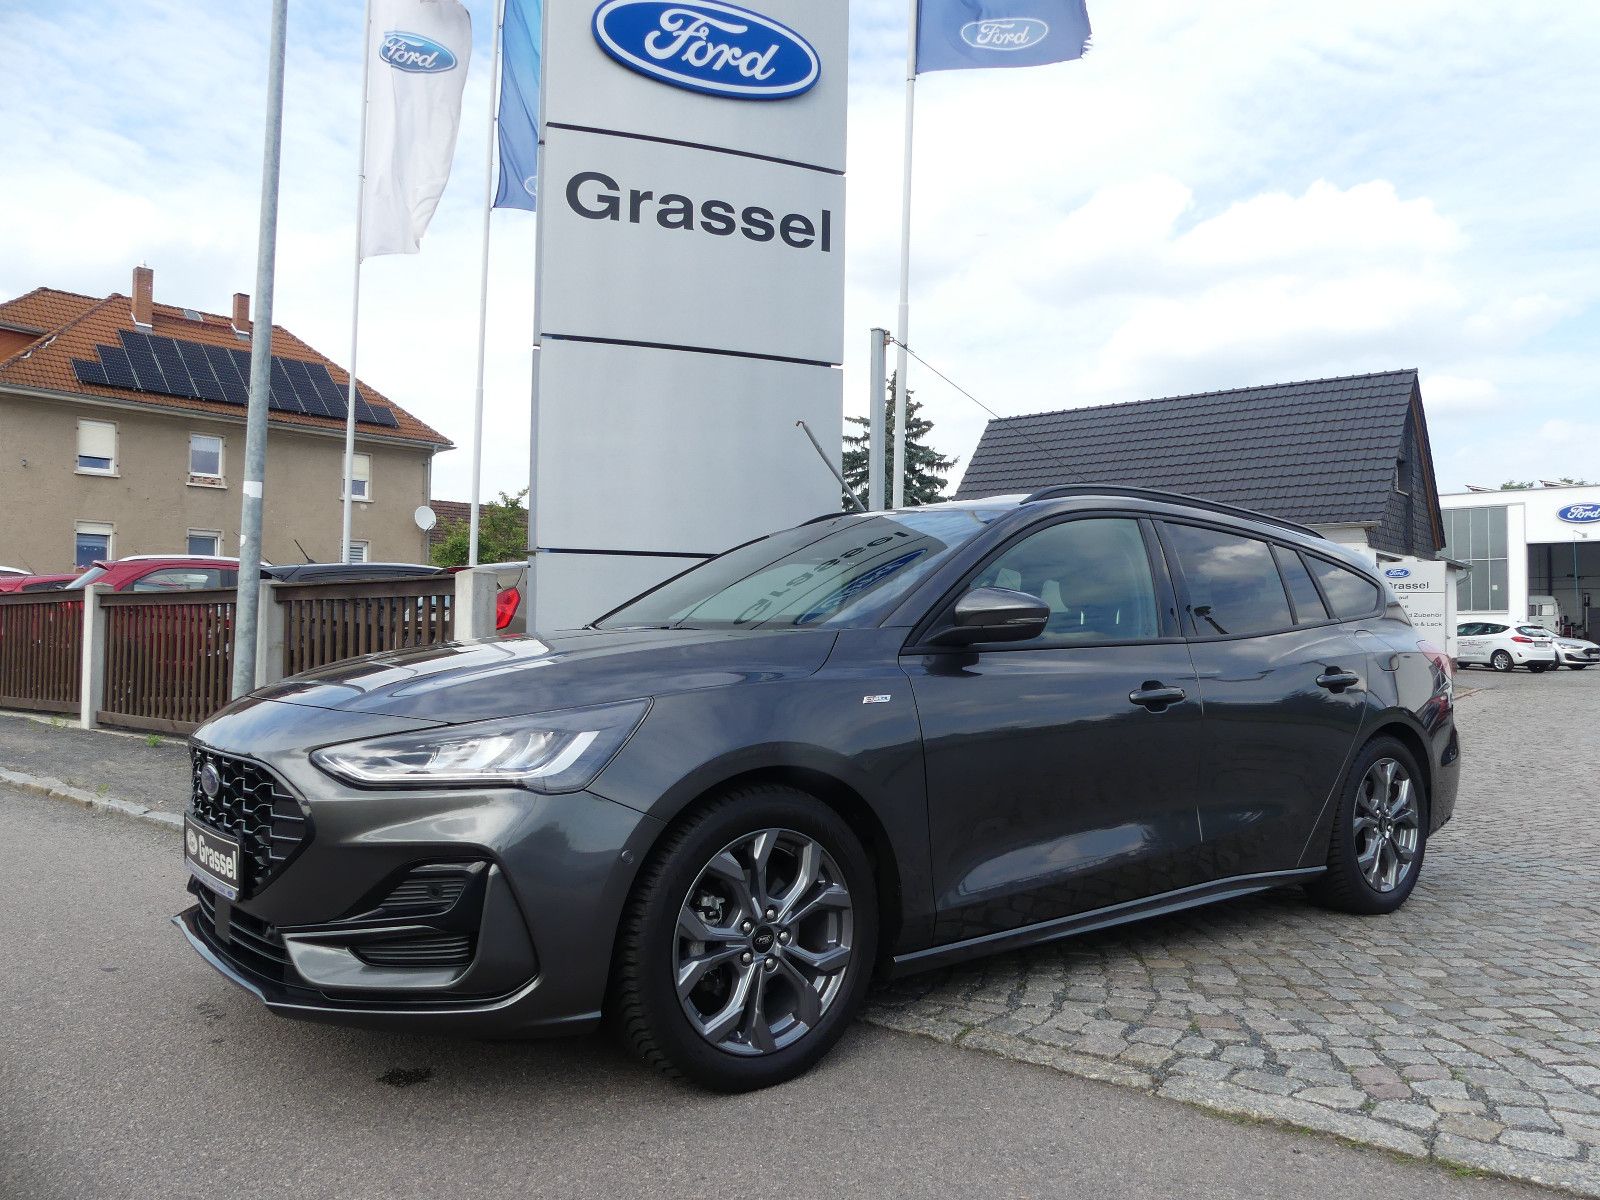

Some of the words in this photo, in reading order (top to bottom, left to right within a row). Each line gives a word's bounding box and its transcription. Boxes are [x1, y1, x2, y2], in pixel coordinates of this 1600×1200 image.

[644, 8, 780, 80] Ford
[976, 23, 1031, 45] Ford
[384, 37, 440, 68] Ford
[565, 171, 832, 253] Grassel
[1567, 505, 1600, 519] Ford
[1388, 568, 1406, 576] Ford
[1389, 581, 1429, 590] rassel
[199, 834, 237, 880] Grassel
